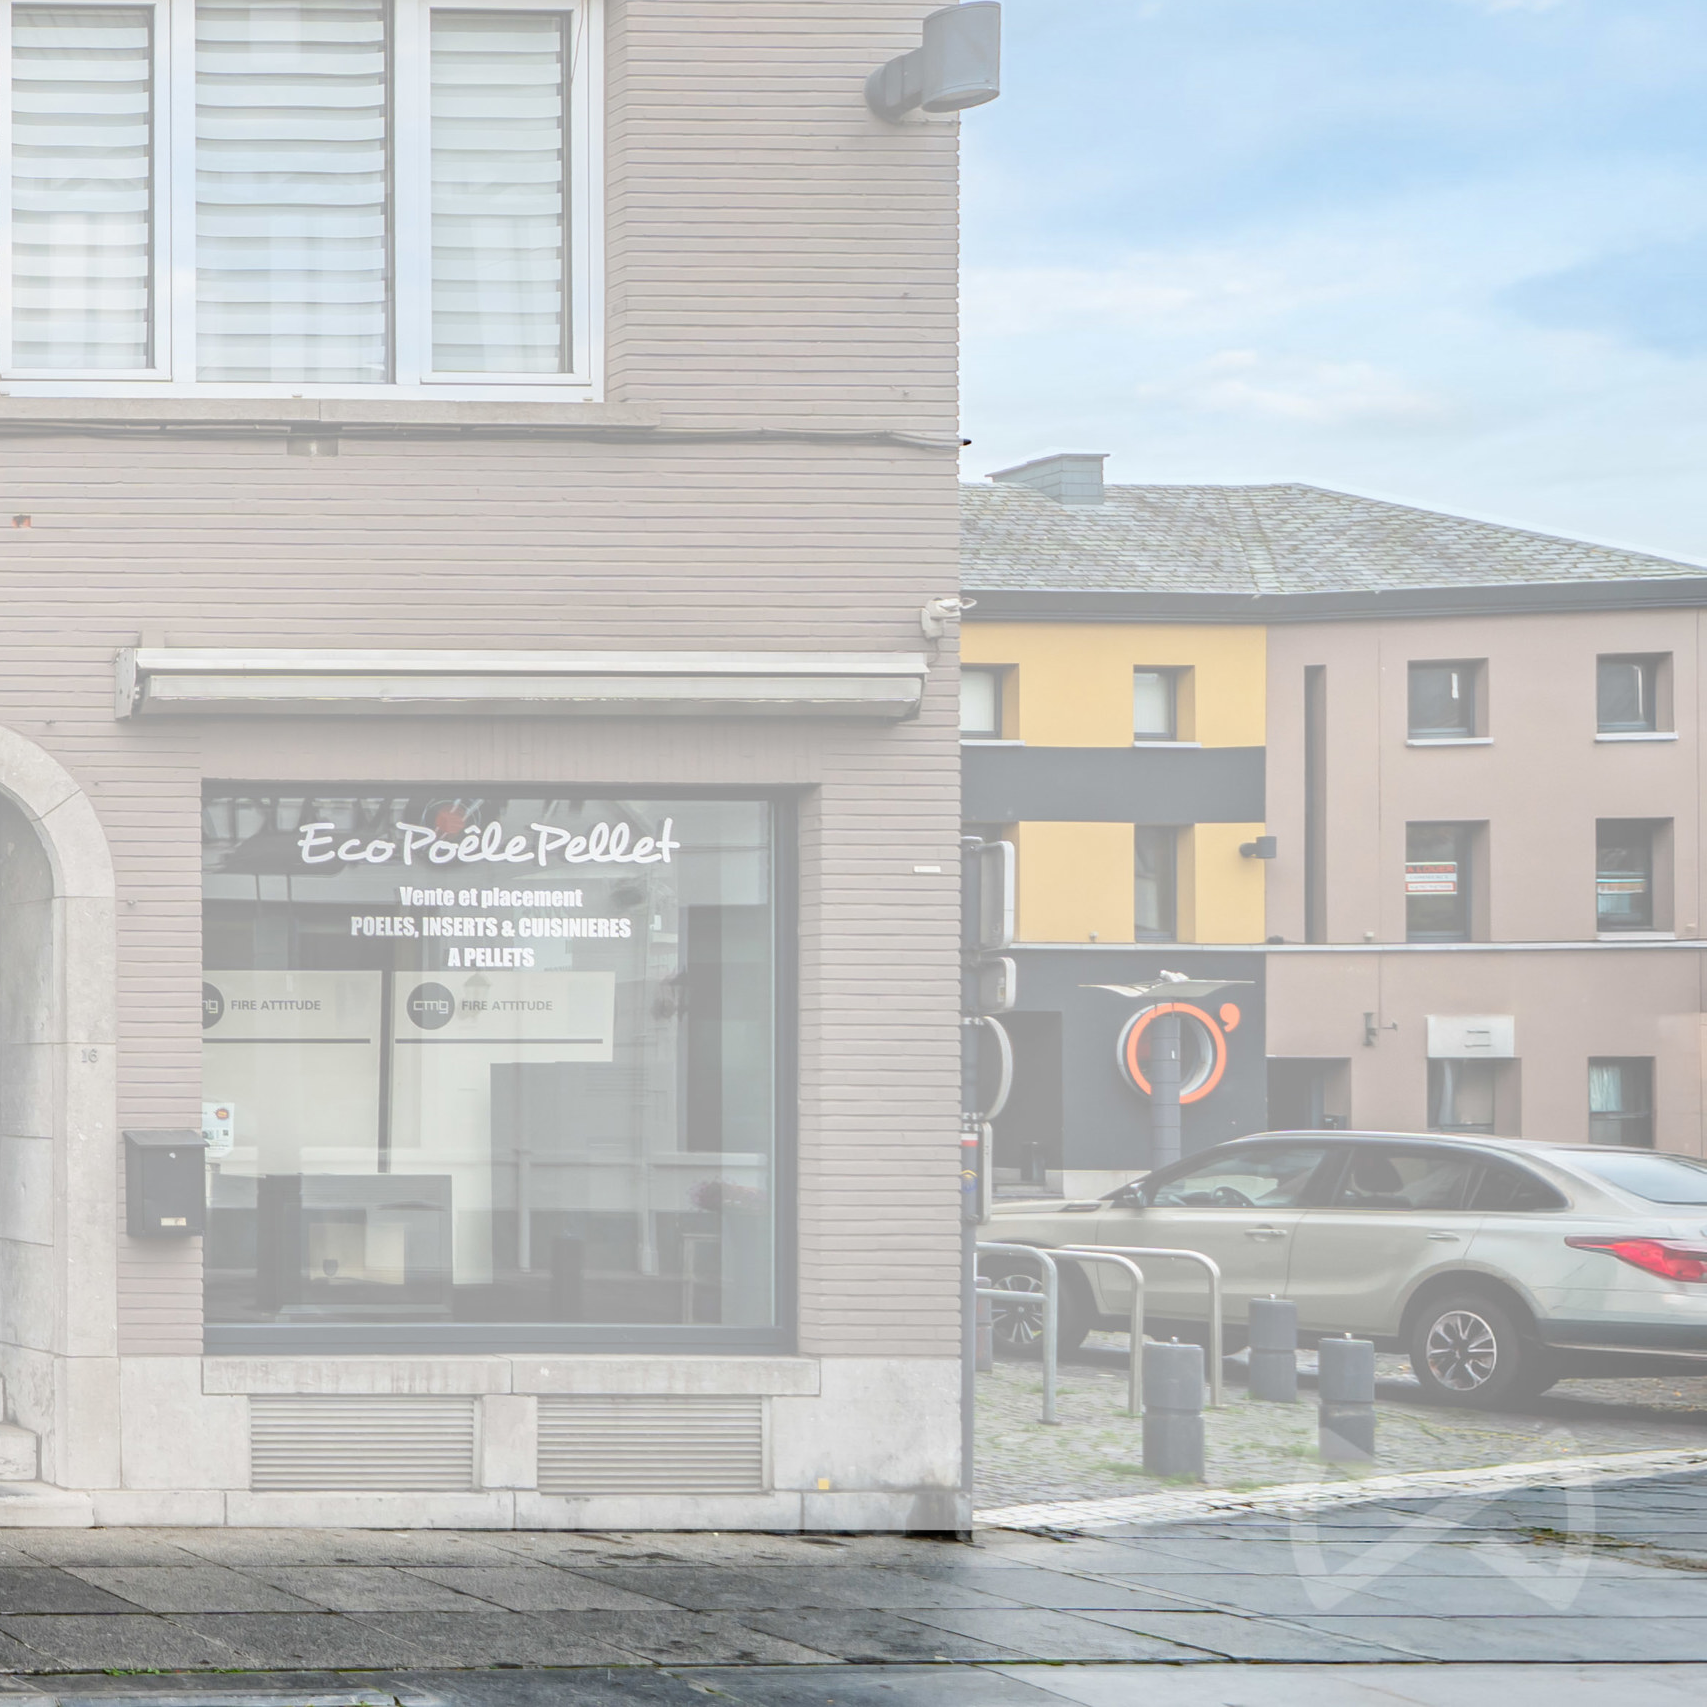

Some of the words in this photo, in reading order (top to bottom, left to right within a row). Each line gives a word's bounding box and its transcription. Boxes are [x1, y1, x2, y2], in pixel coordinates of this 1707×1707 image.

[399, 887, 454, 907] Vente
[458, 888, 478, 907] et
[481, 888, 582, 909] placement
[351, 917, 419, 939] POELES,
[423, 917, 497, 937] INSERTS
[501, 921, 515, 937] &
[519, 918, 631, 938] CUISINIERES
[447, 948, 461, 967] A
[464, 948, 535, 967] PELLETS
[231, 1000, 257, 1011] FIRE
[261, 1000, 322, 1011] ATTITUDE
[413, 1000, 449, 1014] cmg
[462, 1000, 487, 1011] FIRE
[491, 1000, 553, 1011] ATTITUDE
[81, 1048, 98, 1064] 16
